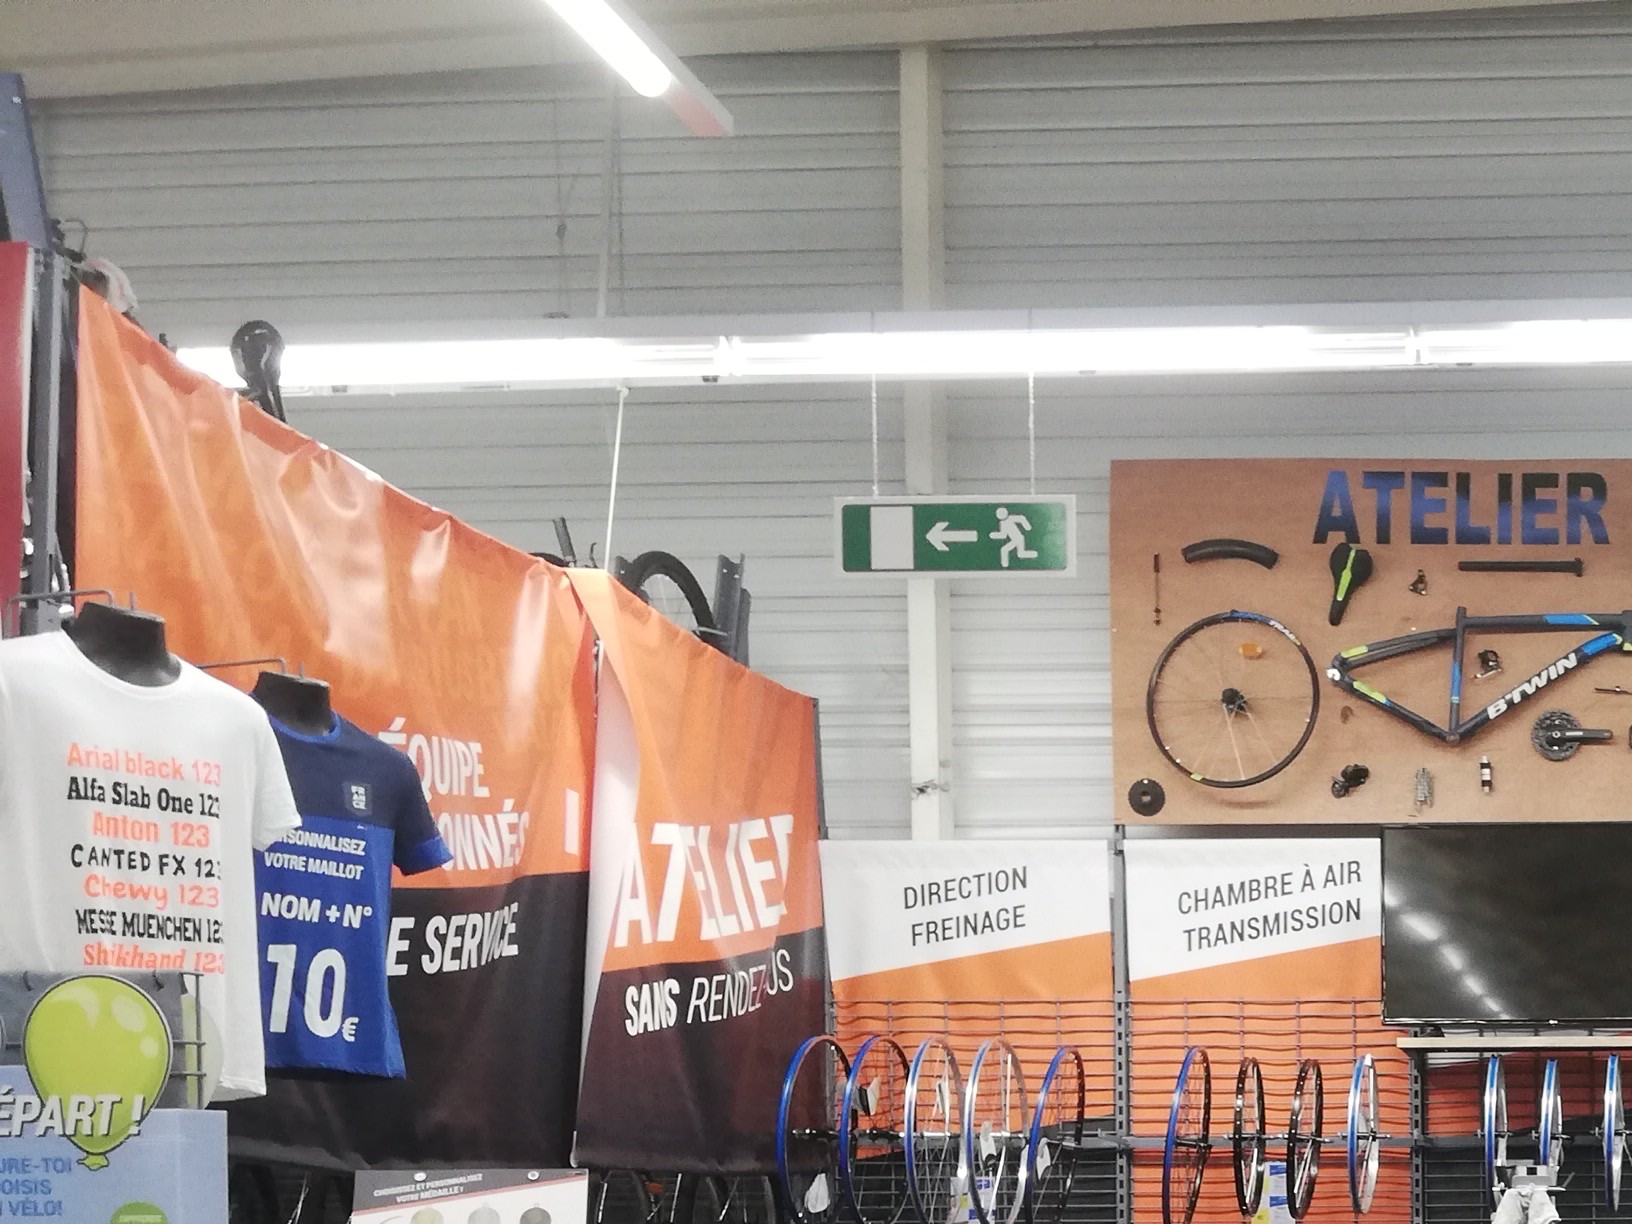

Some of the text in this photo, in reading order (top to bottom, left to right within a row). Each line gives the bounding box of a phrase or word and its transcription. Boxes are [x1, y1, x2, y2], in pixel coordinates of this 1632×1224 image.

[1313, 470, 1611, 546] ATELIER
[66, 742, 221, 786] Arial black 123
[67, 776, 106, 802] Alfa
[111, 780, 151, 809] Slab
[157, 787, 193, 814] One
[93, 811, 210, 848] Anton 123
[71, 844, 151, 872] CANTED
[158, 853, 186, 876] FX
[264, 852, 364, 880] VOTRE MAILLOT
[82, 872, 219, 911] Chewy 123
[903, 864, 1029, 911] DIRECTION
[1178, 860, 1363, 916] CHAMBRE À AIR
[121, 911, 202, 943] MUENCHEN
[261, 892, 322, 924] NOM
[325, 904, 341, 923] +
[911, 903, 1027, 947] FREINAGE
[1183, 898, 1363, 952] TRANSMISSION
[625, 978, 680, 1037] SANS
[0, 1087, 124, 1137] ÉPART
[0, 1156, 72, 1175] URE-TOI
[1, 1178, 52, 1196] OISIS
